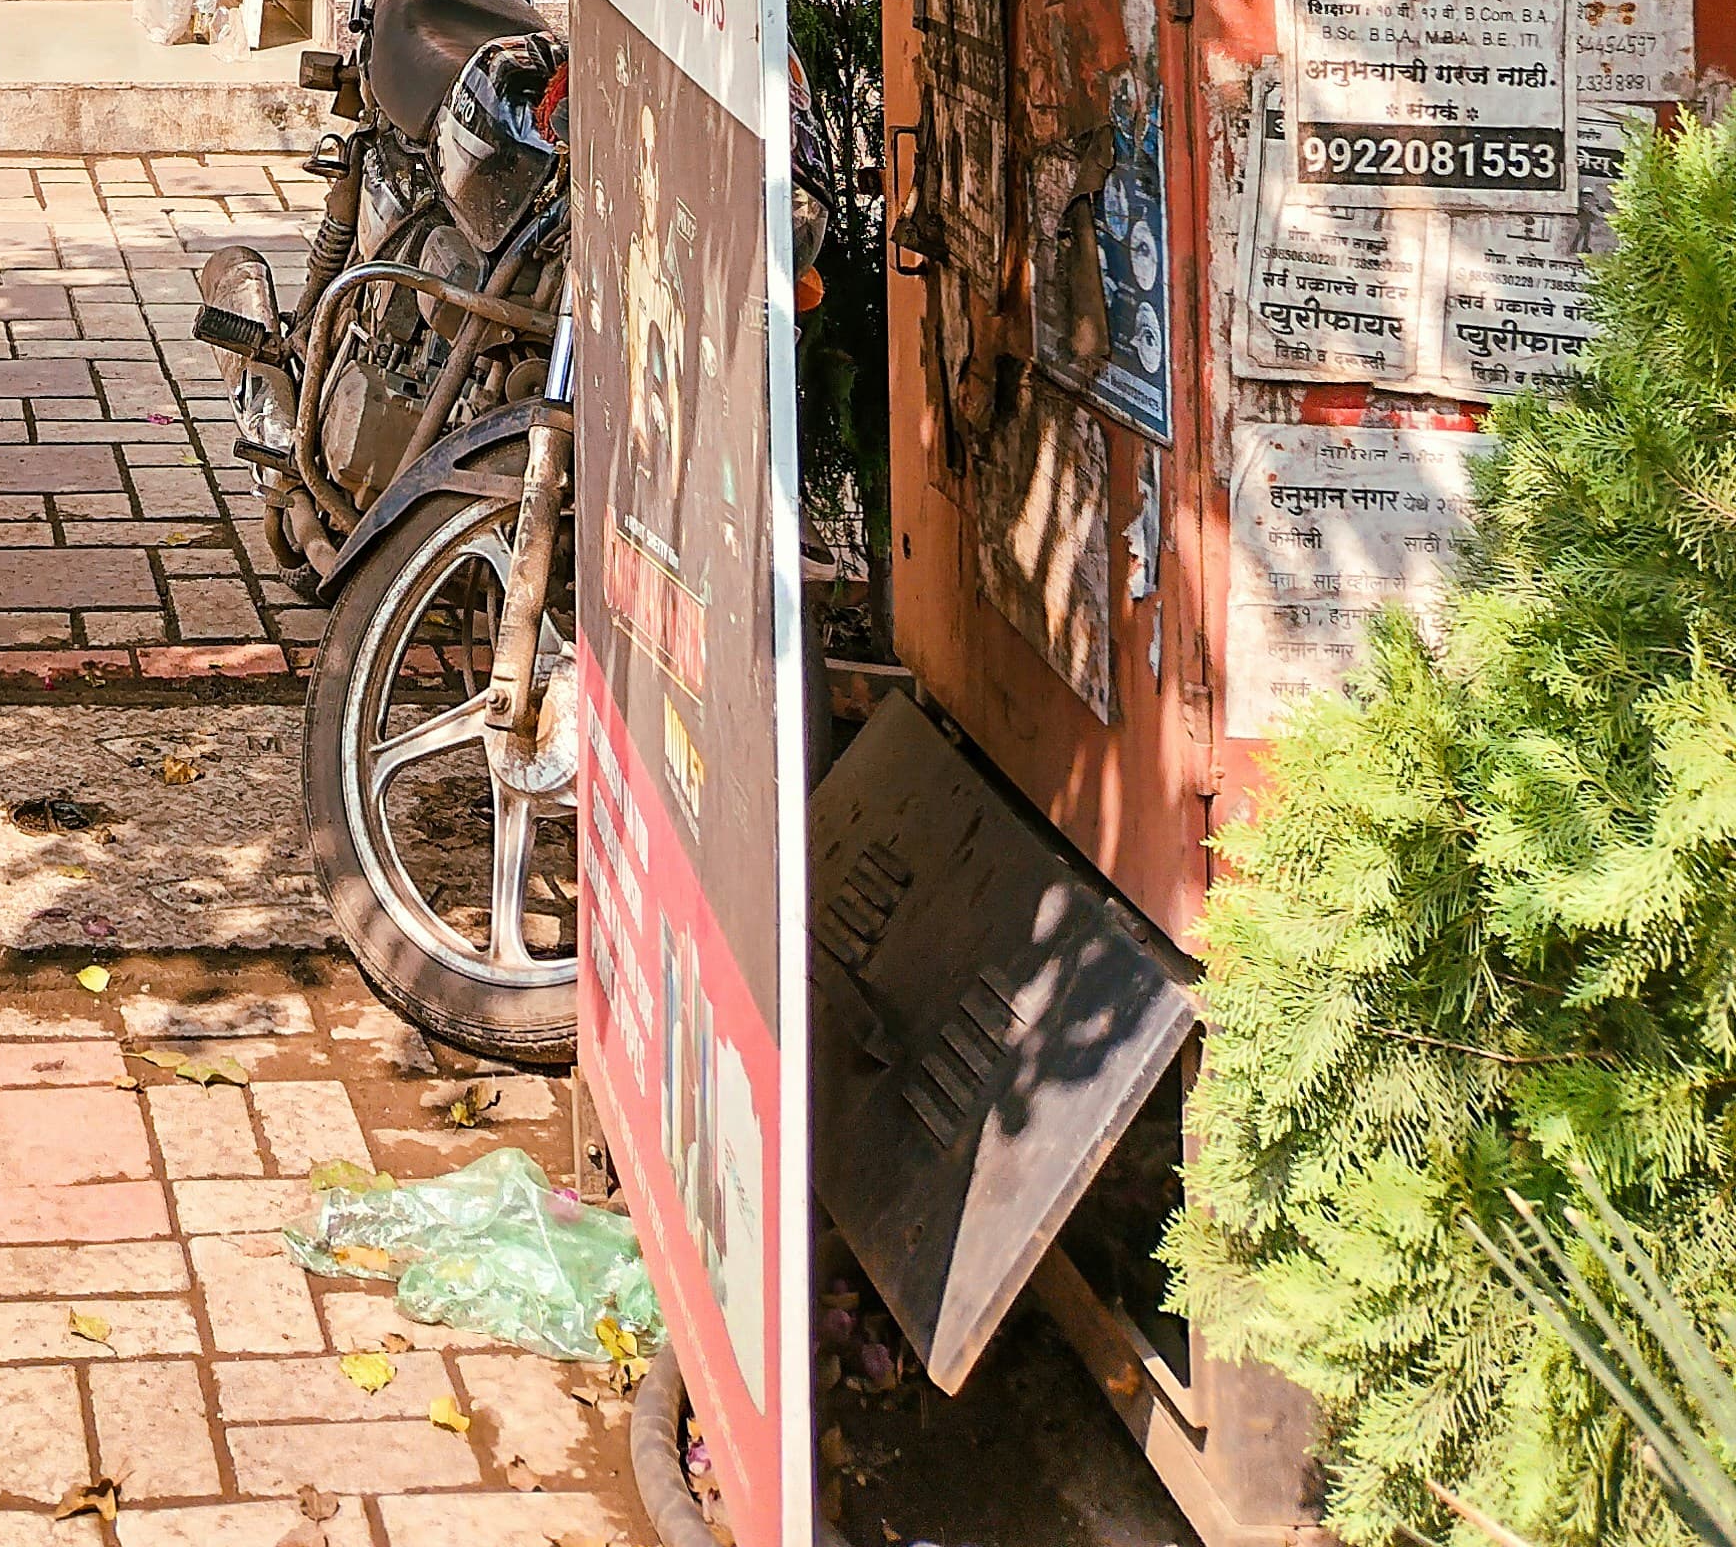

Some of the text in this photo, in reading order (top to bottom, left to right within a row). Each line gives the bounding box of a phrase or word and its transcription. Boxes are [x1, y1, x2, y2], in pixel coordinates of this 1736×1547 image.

[1307, 0, 1361, 17] शिक्षण
[1306, 59, 1556, 88] अनुभवाची गरज नाही.
[1406, 99, 1459, 121] संपर्क
[1302, 137, 1556, 179] 9922081553
[1262, 268, 1409, 299] सर्व प्रकारचे वॉटर
[1260, 295, 1405, 340] प्युरीफायर
[1457, 291, 1597, 321] सर्व प्रकारचे वॉट
[1456, 319, 1587, 357] प्युरीफाय
[1316, 348, 1328, 363] व
[1514, 370, 1526, 385] व
[1270, 484, 1347, 516] हनुमान
[1351, 487, 1400, 512] नगर
